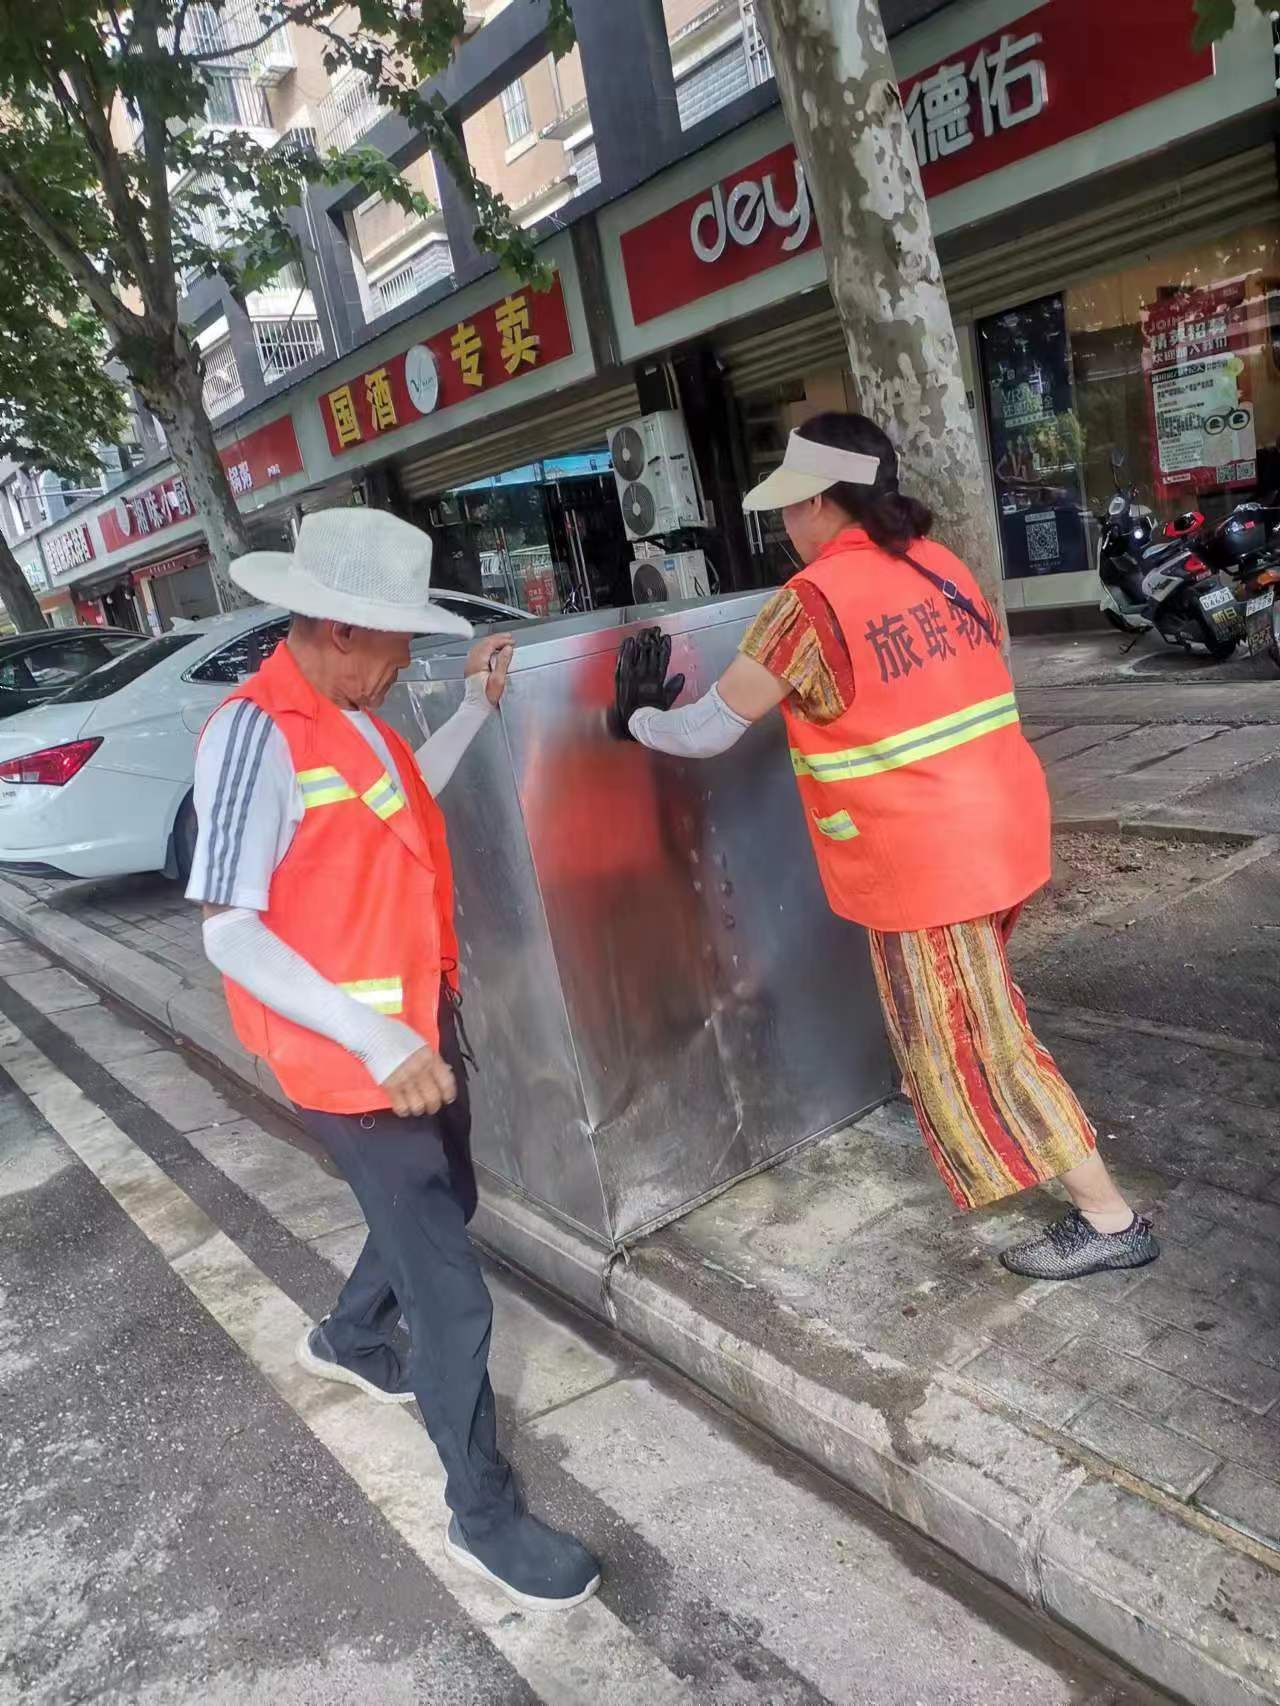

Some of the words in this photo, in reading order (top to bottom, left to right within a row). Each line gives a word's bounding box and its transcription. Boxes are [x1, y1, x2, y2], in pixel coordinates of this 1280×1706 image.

[904, 32, 1048, 167] 德佑
[328, 367, 398, 449] 国酒
[450, 295, 540, 387] 专卖
[864, 597, 1001, 684] 旅联物
